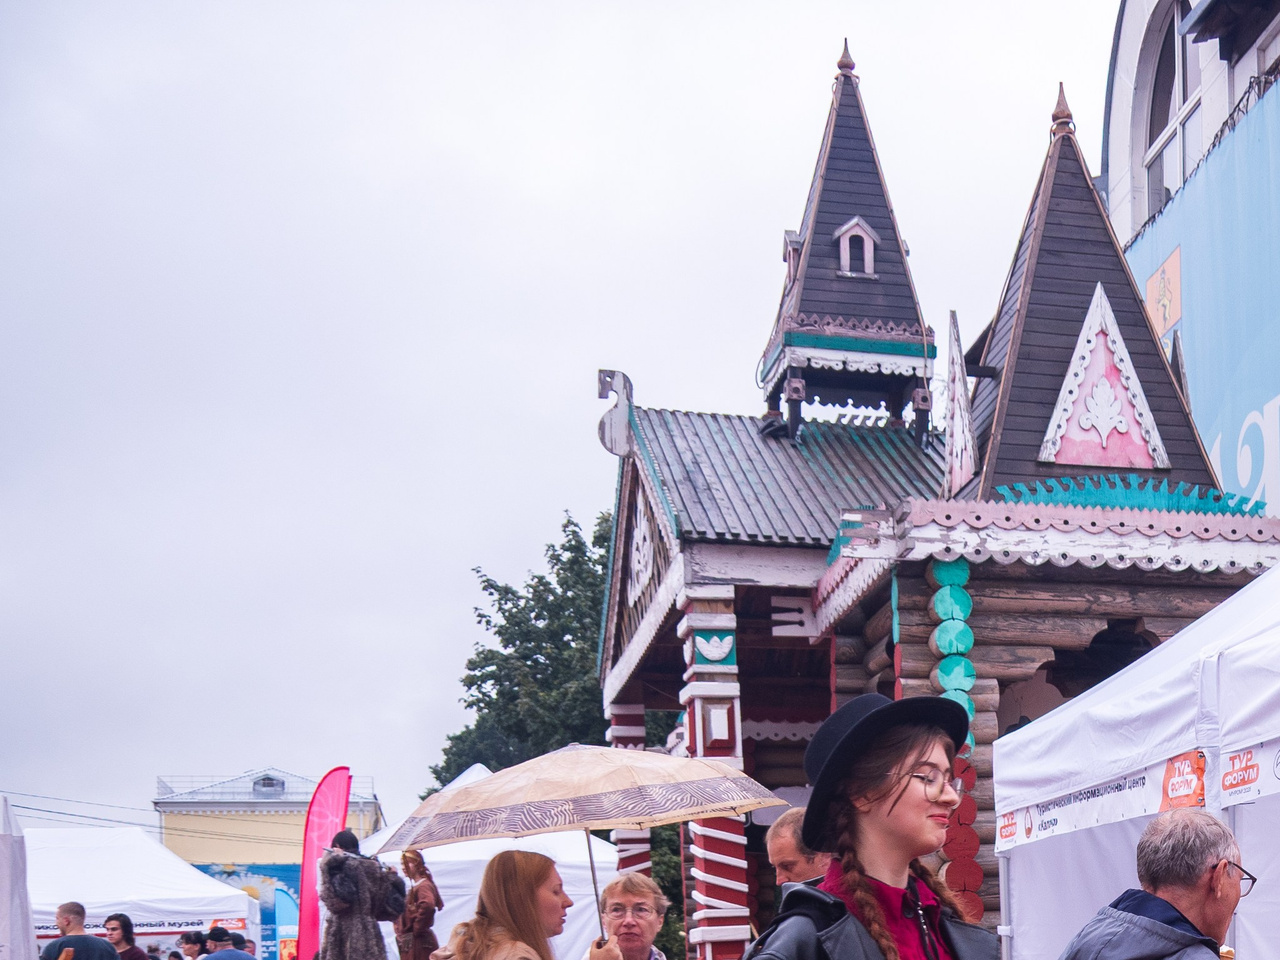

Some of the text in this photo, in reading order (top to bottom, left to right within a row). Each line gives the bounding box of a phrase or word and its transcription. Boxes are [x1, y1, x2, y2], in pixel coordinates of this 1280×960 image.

[1174, 760, 1192, 778] ТУР
[1229, 750, 1253, 771] ТУР
[1224, 767, 1257, 787] ФОРУМ
[1036, 776, 1146, 817] Туристический информационный центр
[167, 919, 204, 929] музей
